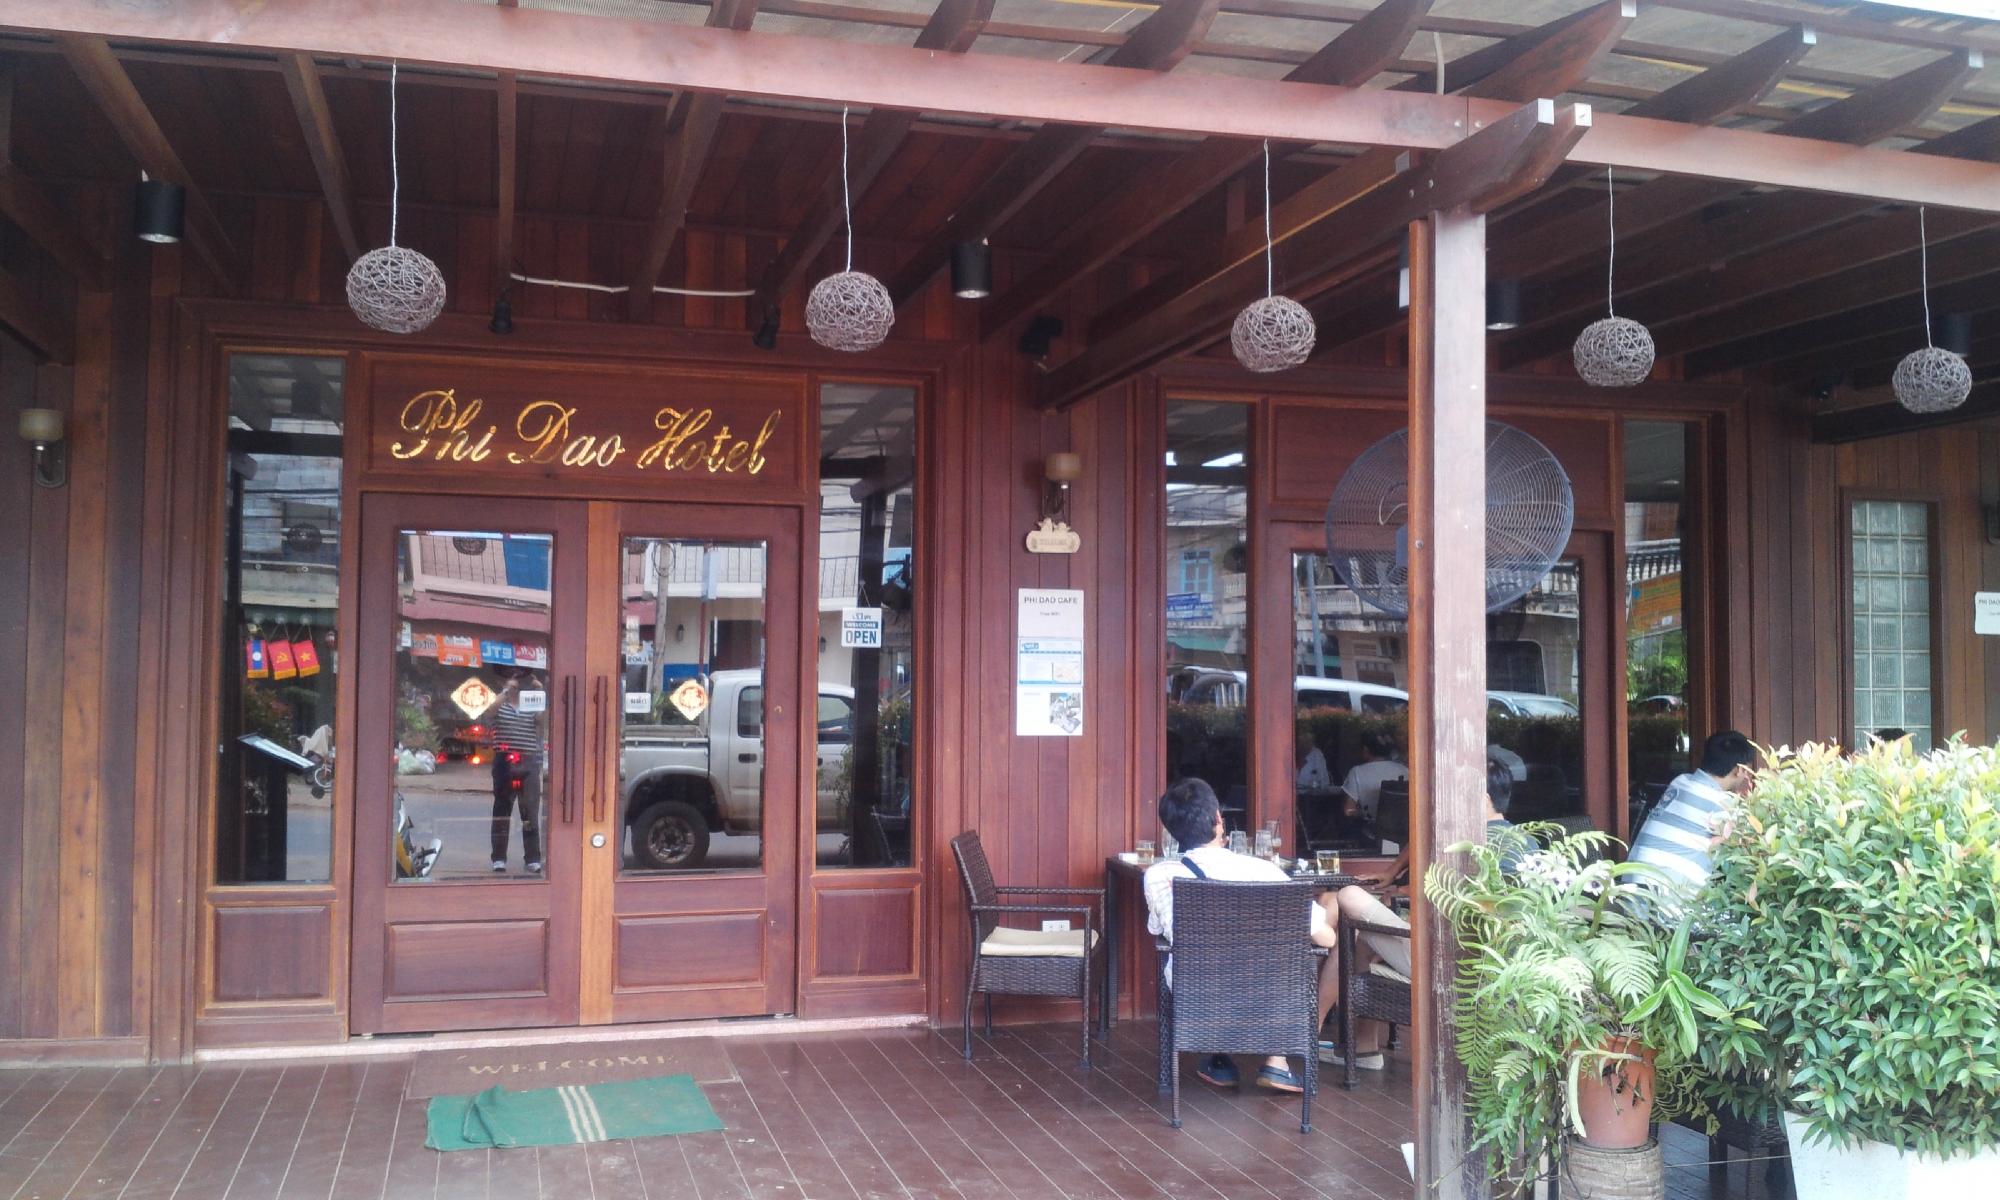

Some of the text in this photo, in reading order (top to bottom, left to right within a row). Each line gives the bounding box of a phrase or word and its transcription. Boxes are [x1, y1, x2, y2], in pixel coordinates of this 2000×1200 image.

[391, 388, 782, 475] Phi Dao Hotel
[846, 630, 876, 644] OPEN
